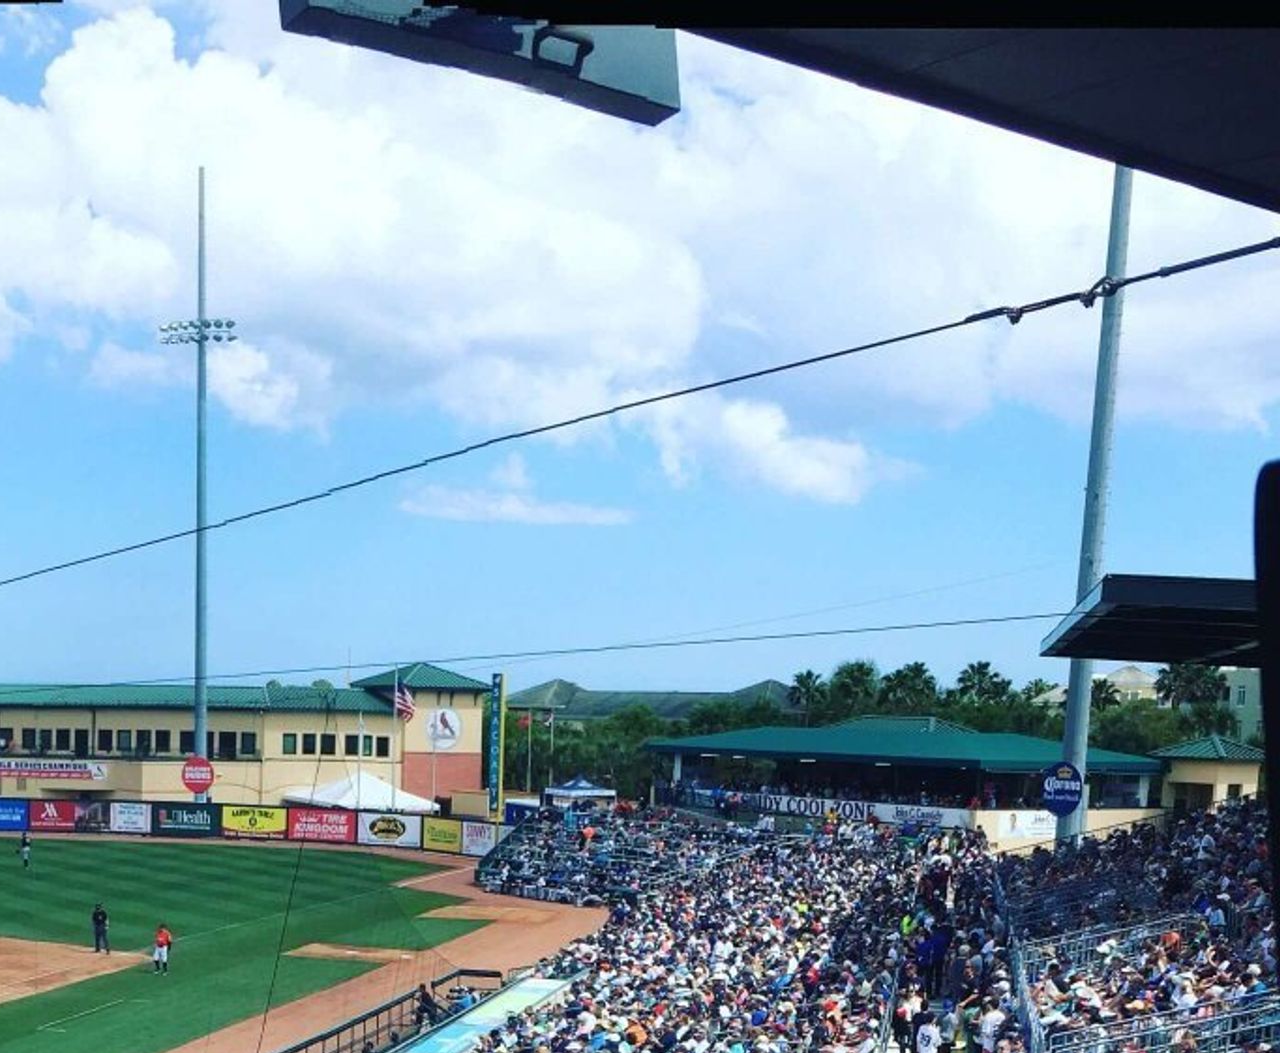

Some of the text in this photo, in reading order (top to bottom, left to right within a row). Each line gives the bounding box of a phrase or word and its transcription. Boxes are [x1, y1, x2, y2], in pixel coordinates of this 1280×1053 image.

[1044, 776, 1081, 793] Corona
[322, 813, 348, 825] TIRE
[294, 821, 348, 834] KINGDOM
